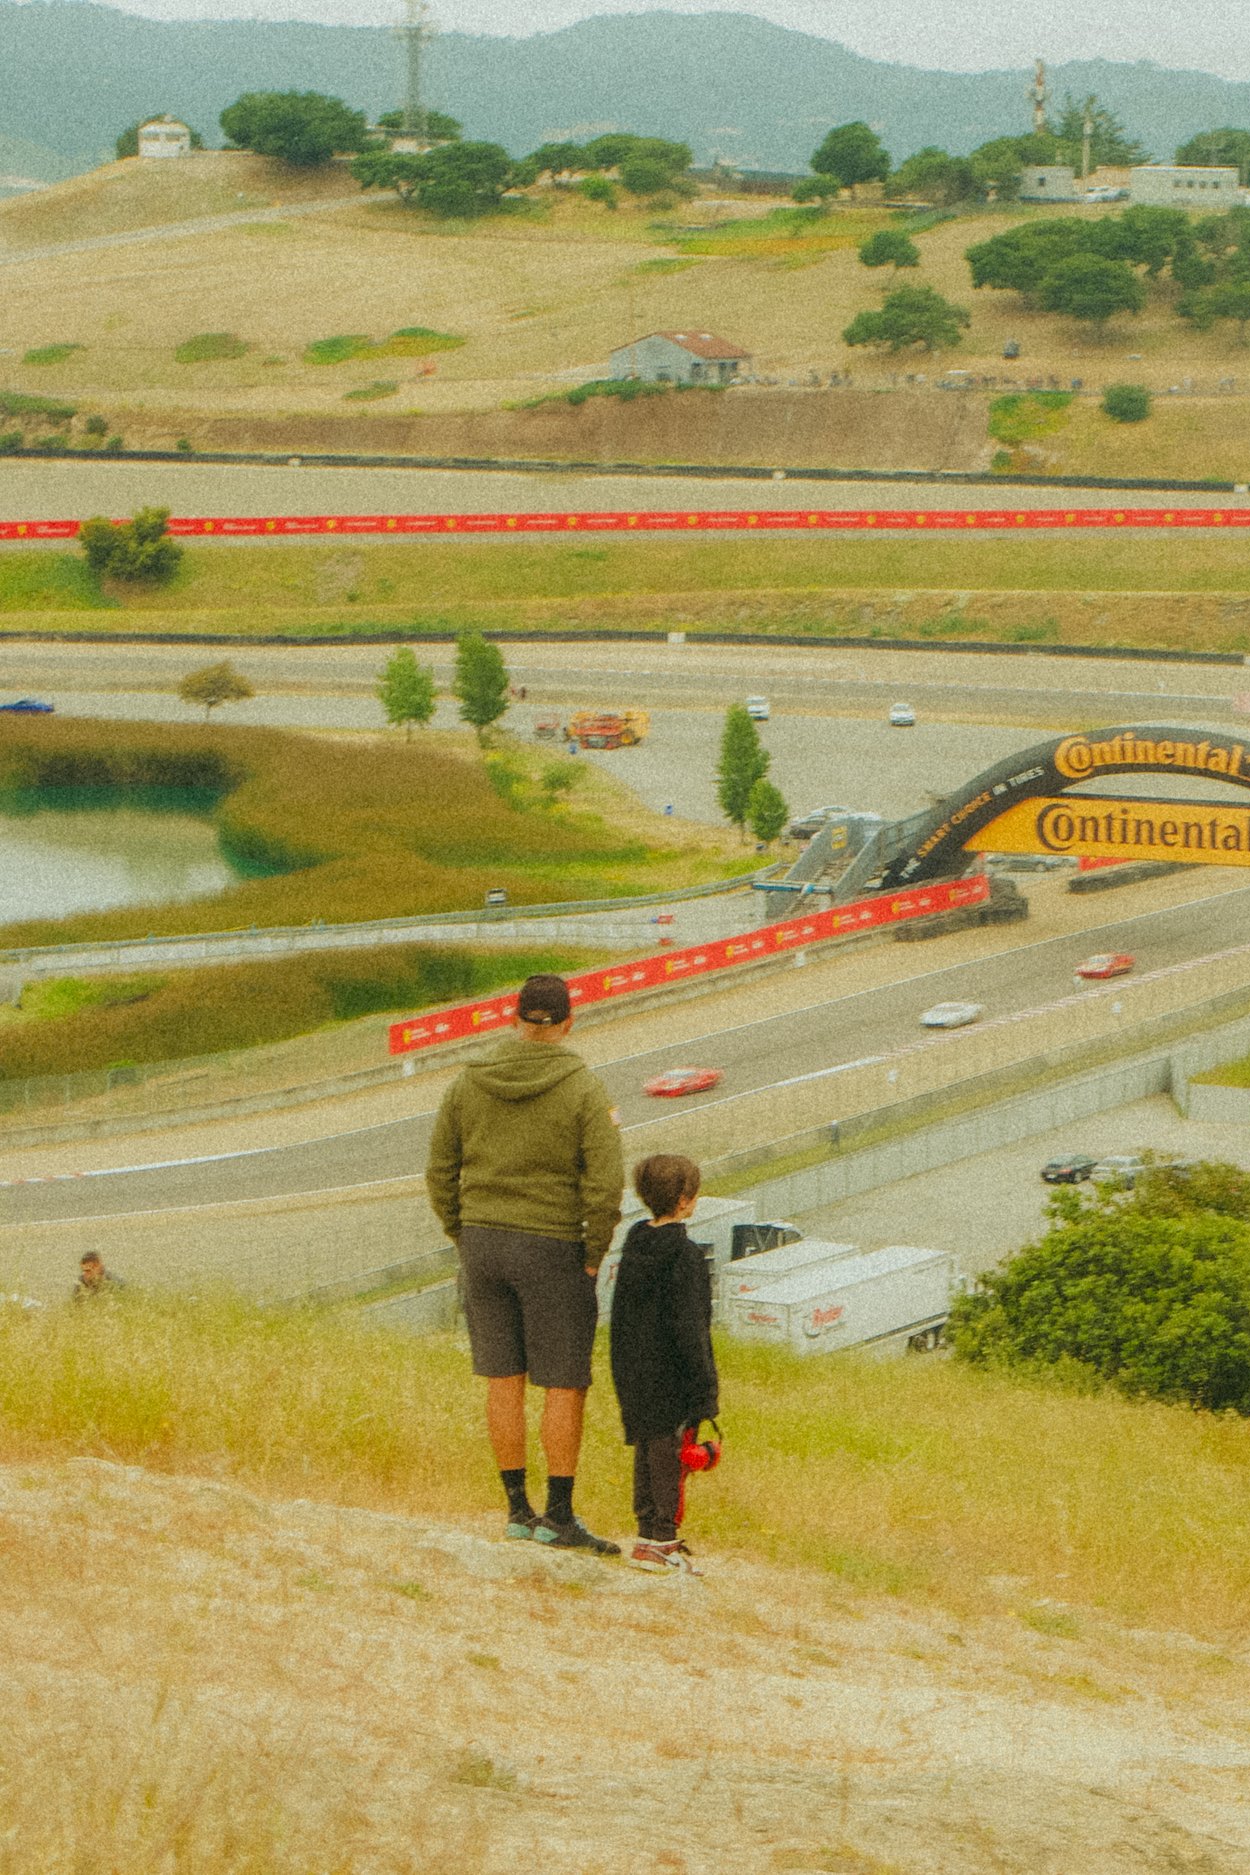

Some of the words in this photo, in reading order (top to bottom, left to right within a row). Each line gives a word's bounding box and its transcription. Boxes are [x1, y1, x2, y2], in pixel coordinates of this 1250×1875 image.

[1053, 731, 1245, 779] Continental
[916, 822, 951, 858] SMART
[950, 791, 993, 825] CHOICE
